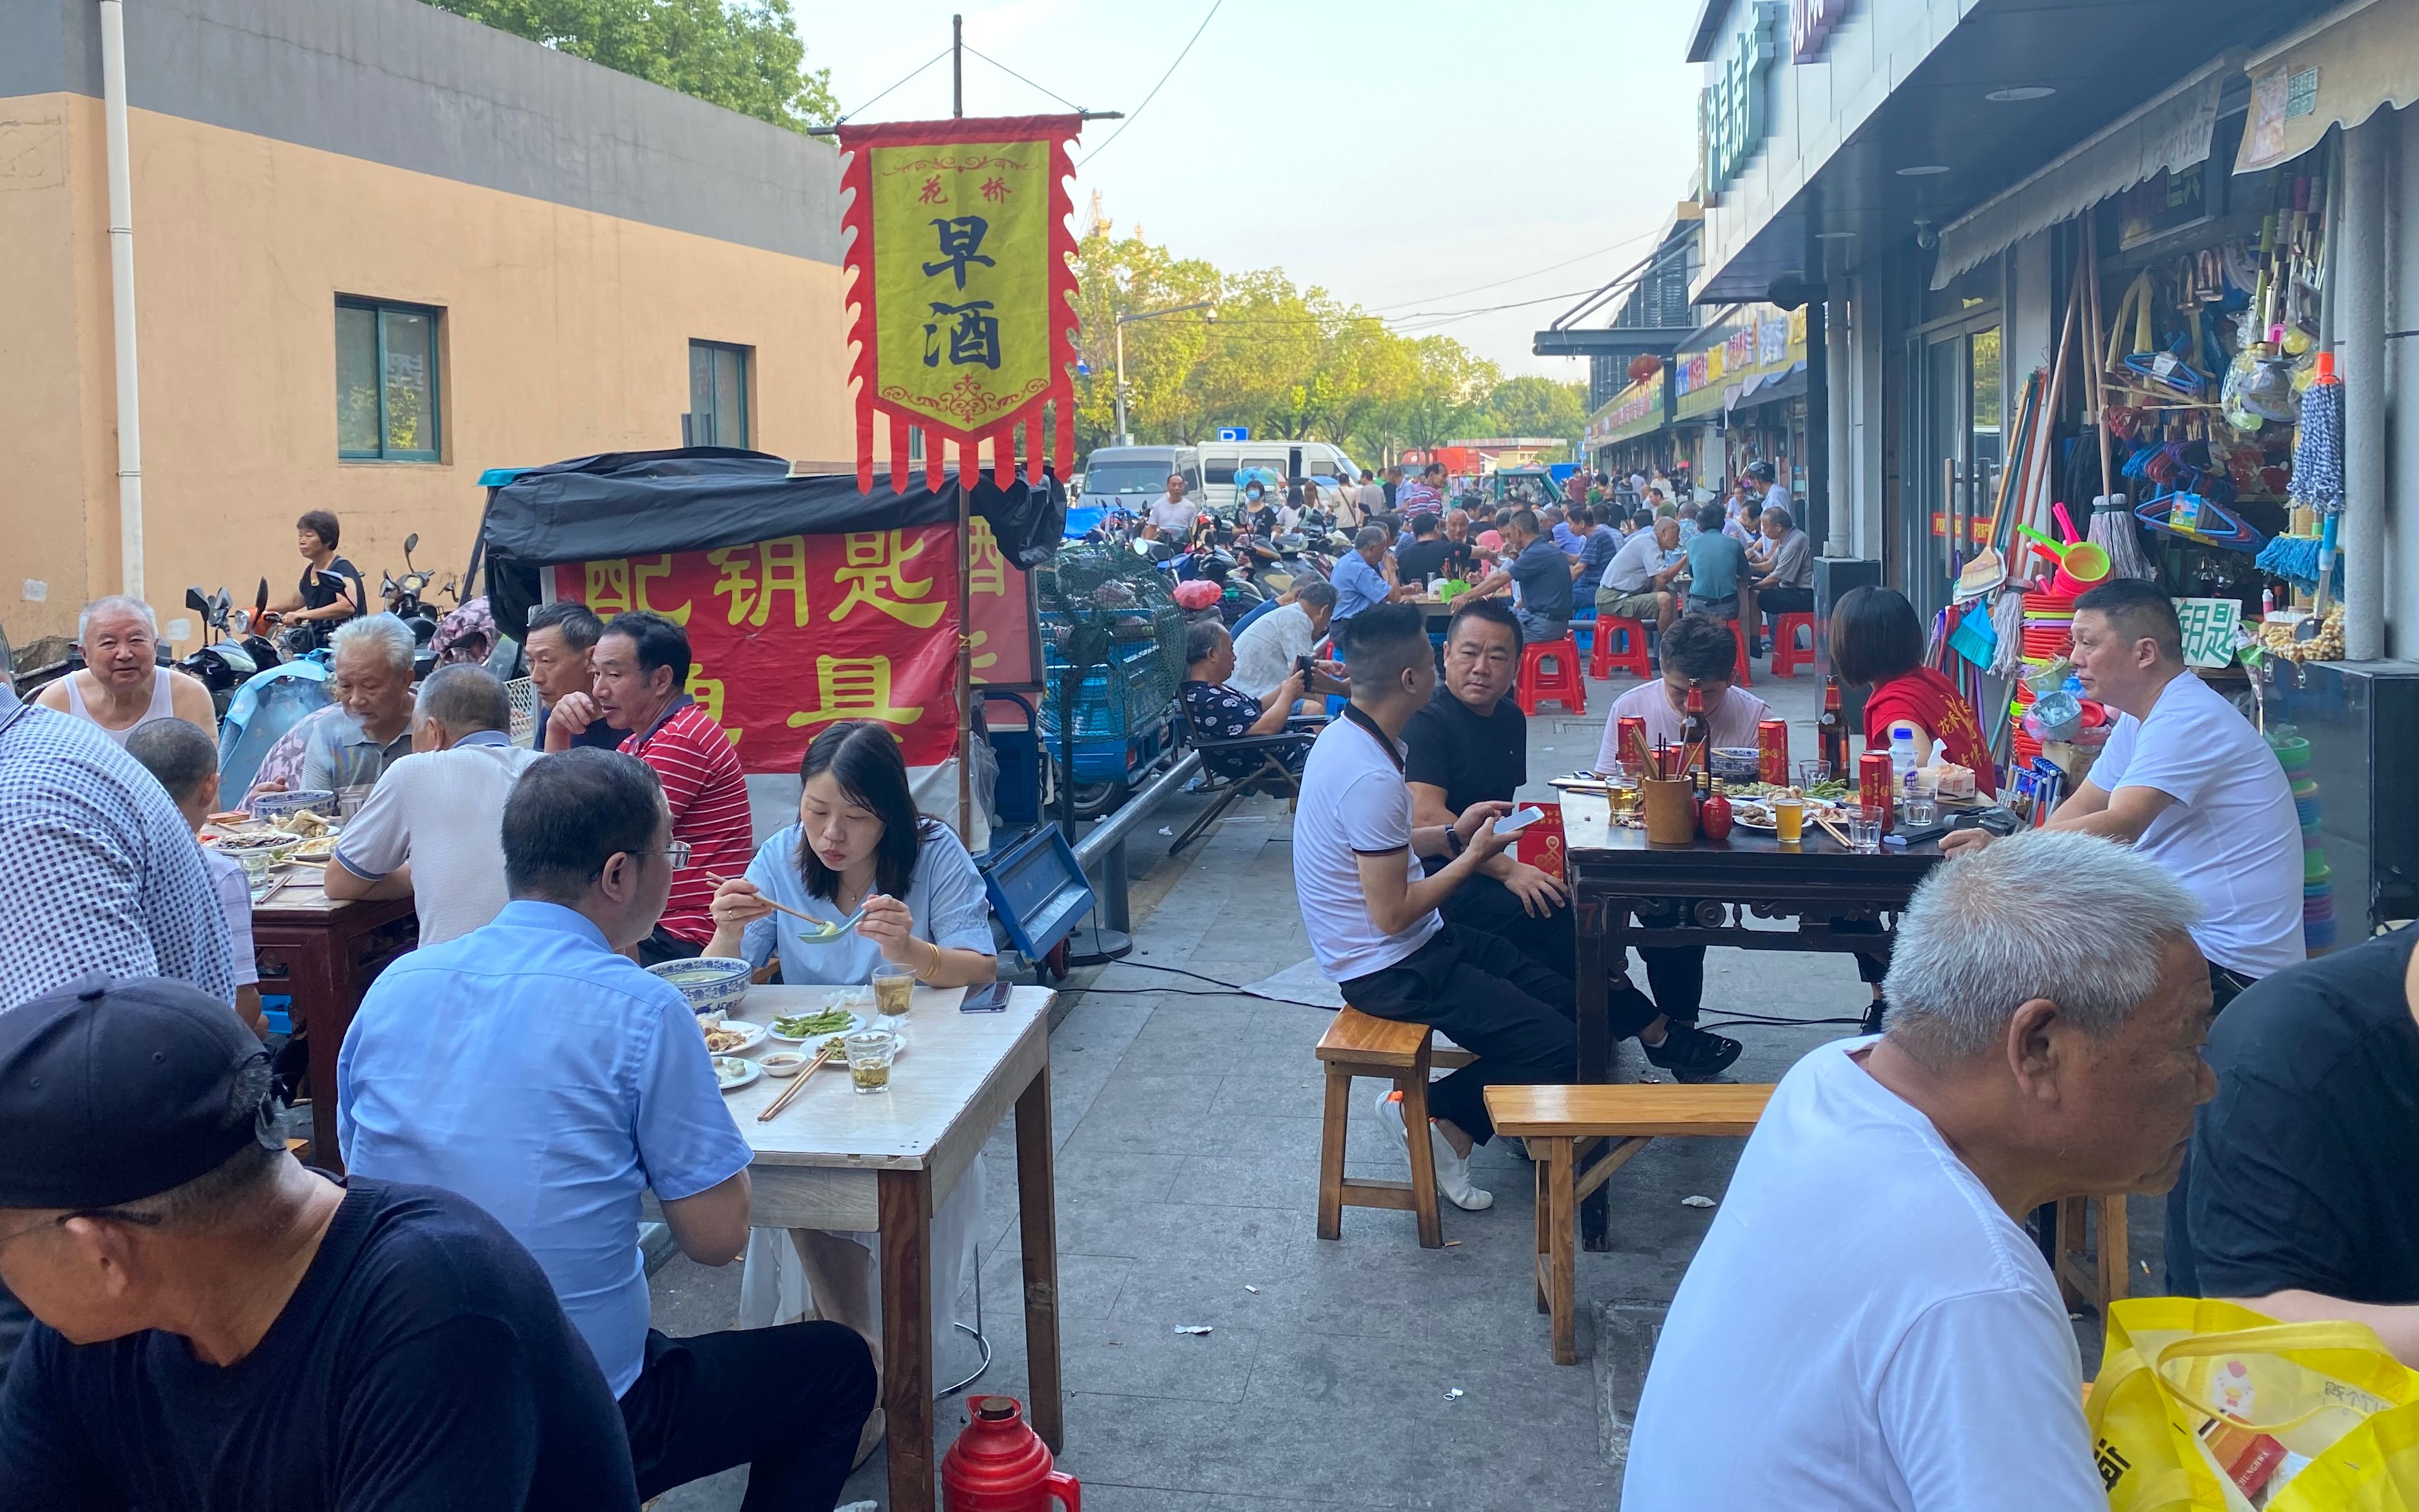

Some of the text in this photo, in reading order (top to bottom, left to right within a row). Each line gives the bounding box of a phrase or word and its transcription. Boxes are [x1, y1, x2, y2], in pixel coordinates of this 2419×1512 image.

[918, 174, 1012, 205] 花桥
[921, 215, 1001, 371] 早酒
[585, 529, 947, 628] 配钥匙
[2178, 601, 2236, 666] 钥匙
